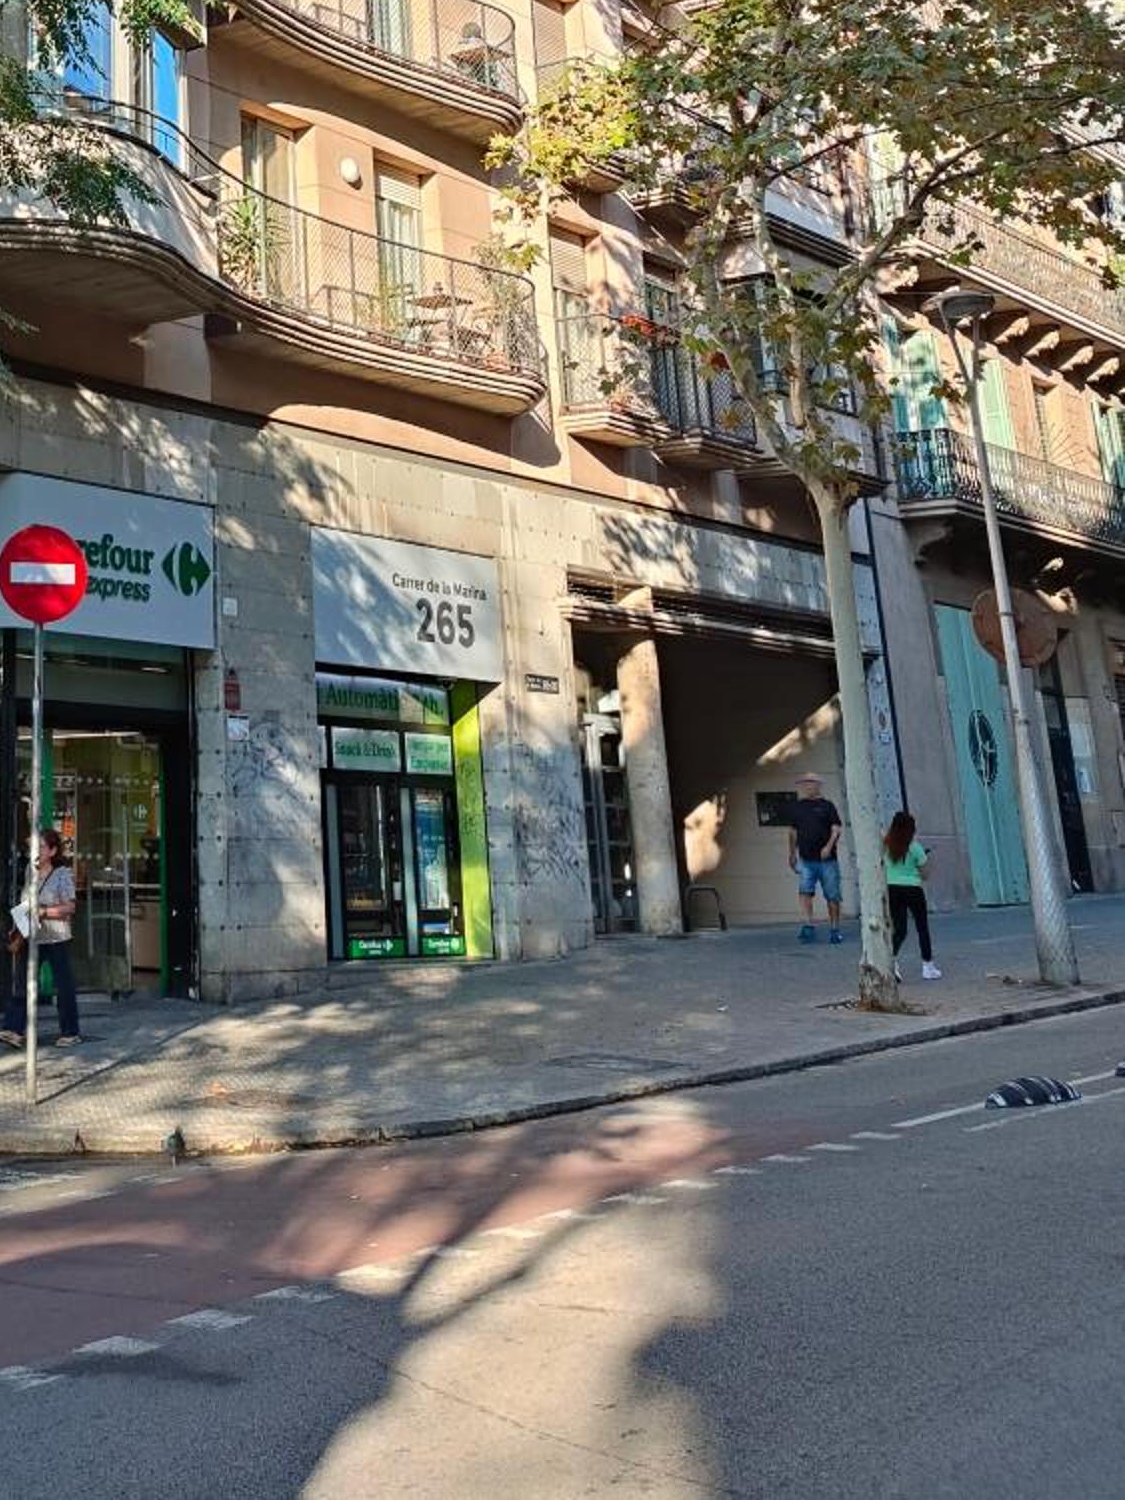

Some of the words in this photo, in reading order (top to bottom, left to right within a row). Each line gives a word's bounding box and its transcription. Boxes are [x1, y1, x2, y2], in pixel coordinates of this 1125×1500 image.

[392, 572, 424, 591] Carrer
[426, 578, 440, 594] de
[453, 583, 487, 601] Marina
[416, 597, 476, 649] 265
